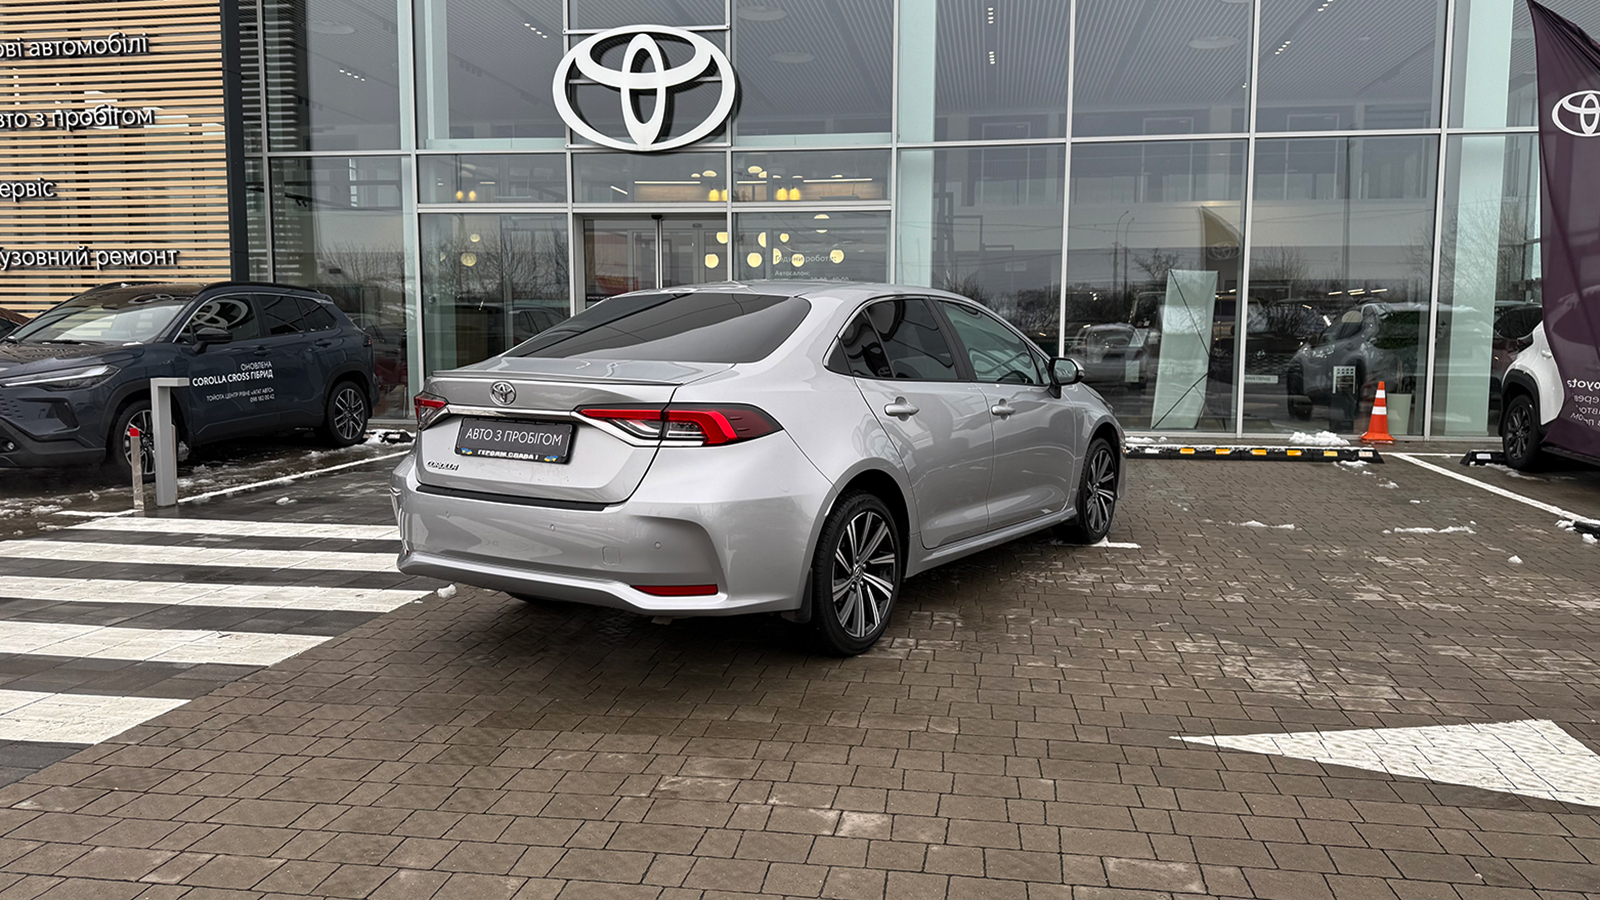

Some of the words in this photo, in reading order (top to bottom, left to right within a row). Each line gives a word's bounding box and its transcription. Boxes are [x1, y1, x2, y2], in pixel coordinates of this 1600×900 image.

[29, 32, 150, 57] автомобілі
[34, 112, 46, 128] з
[52, 104, 156, 131] пробігом
[0, 245, 88, 271] узовний
[96, 250, 179, 270] ремонт
[240, 360, 273, 371] ОНОВЛЕНА
[192, 374, 227, 387] COROLLA
[227, 371, 250, 383] CROSS
[465, 428, 493, 441] АВТО
[503, 430, 562, 446] ПРОБІГОМ
[477, 449, 507, 457] ГЕРОЯМ
[508, 452, 534, 460] СЛАВА
